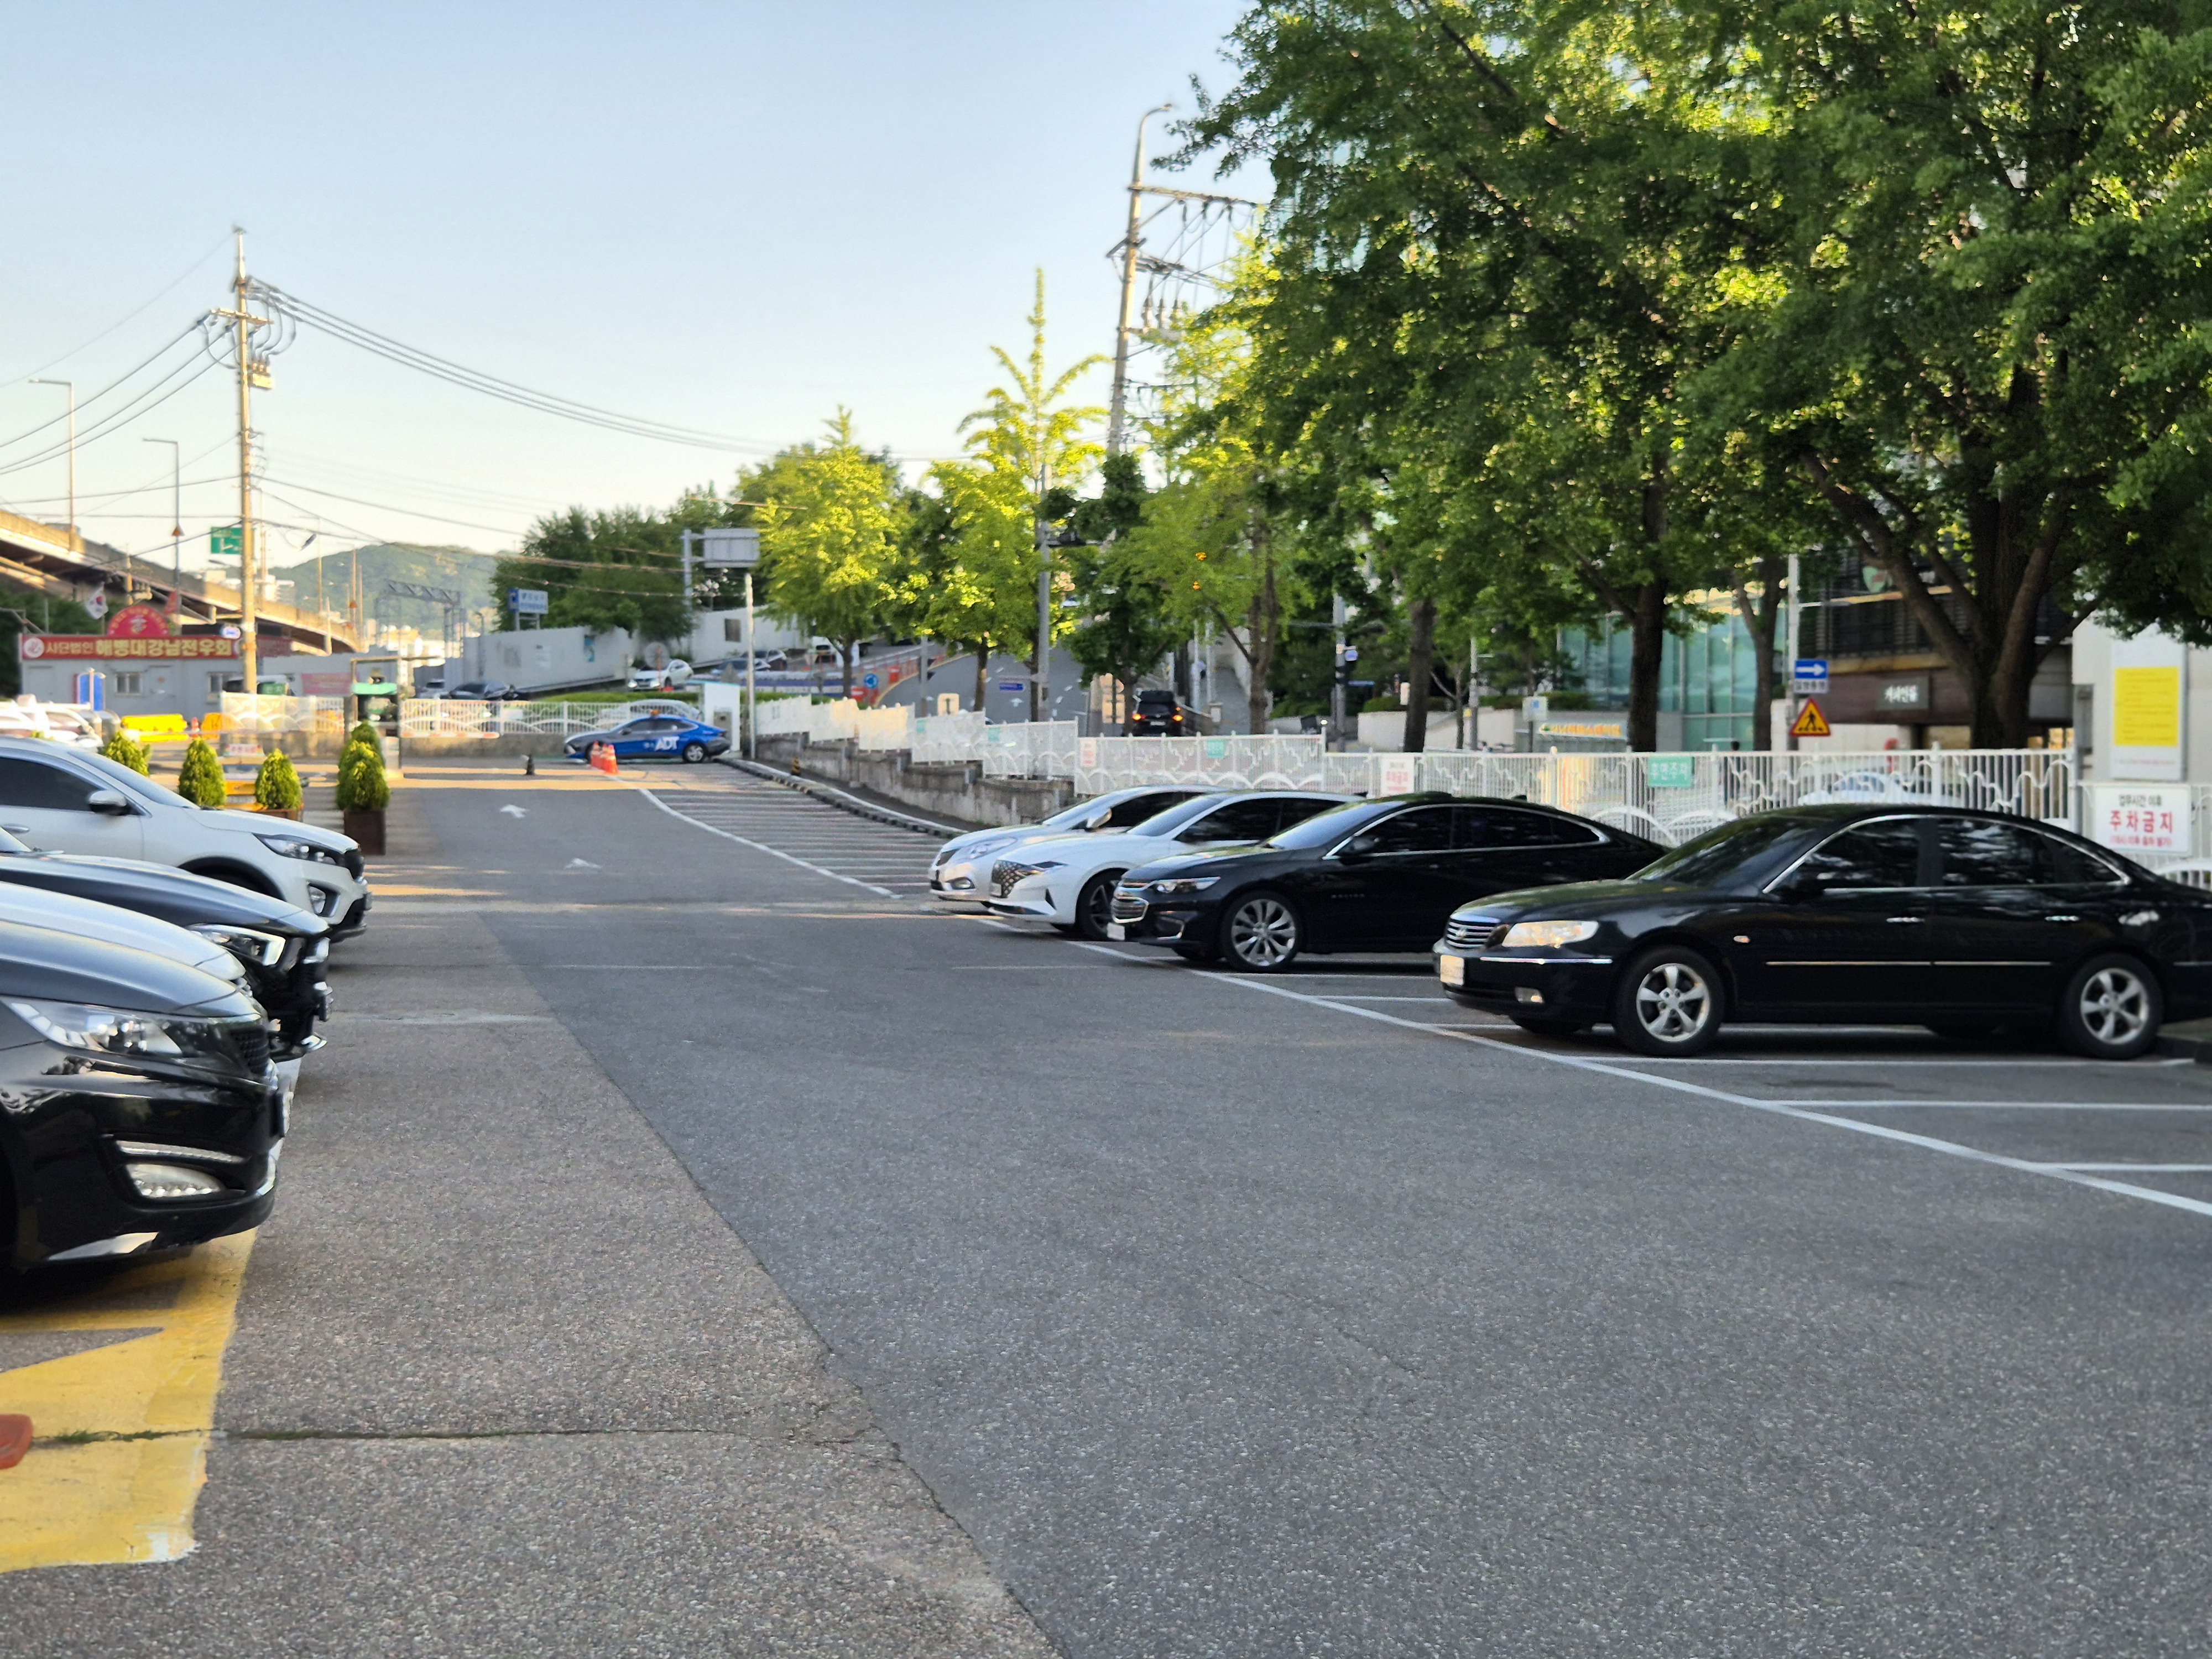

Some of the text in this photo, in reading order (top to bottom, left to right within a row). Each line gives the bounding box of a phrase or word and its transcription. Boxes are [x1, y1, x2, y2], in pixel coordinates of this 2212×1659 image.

[46, 641, 94, 655] 사단법인
[654, 735, 680, 752] ADT
[2110, 810, 2173, 833] 주차금지
